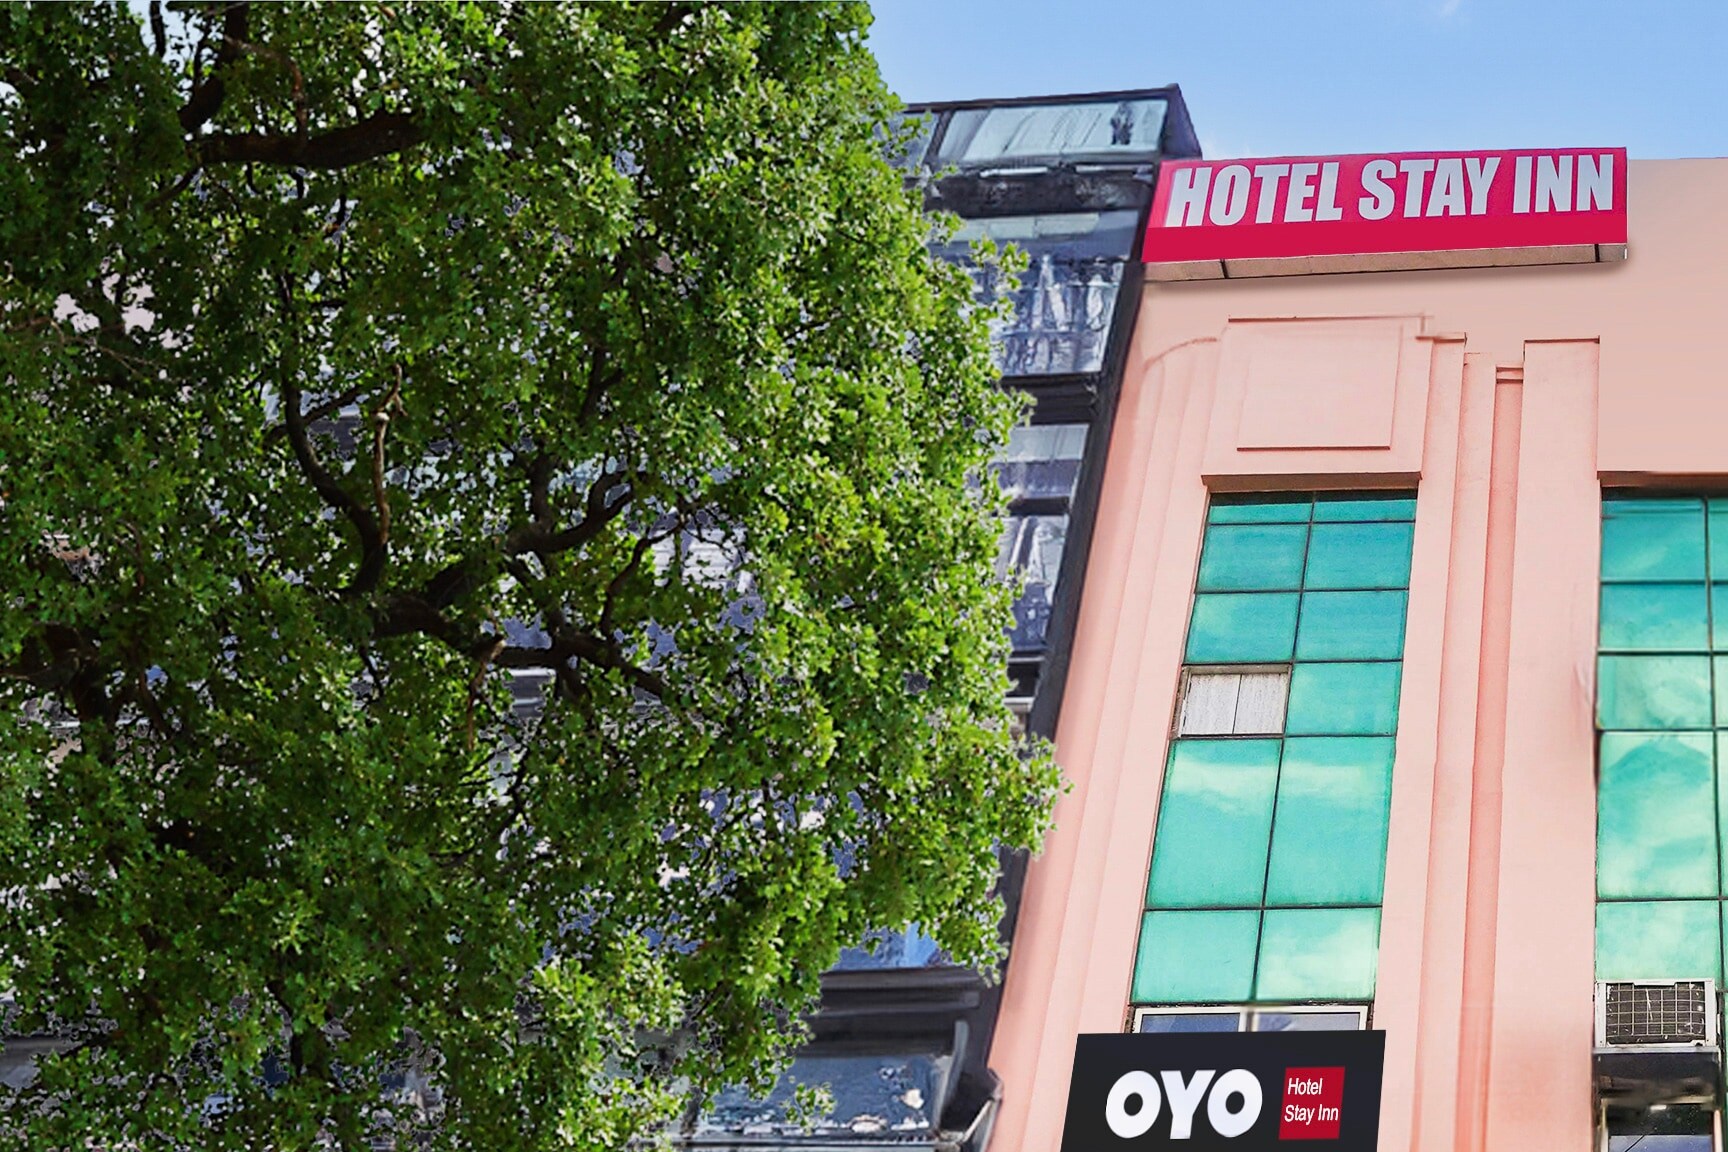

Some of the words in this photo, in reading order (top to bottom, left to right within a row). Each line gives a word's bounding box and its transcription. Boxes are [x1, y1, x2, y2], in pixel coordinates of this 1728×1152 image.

[1164, 159, 1343, 228] HOTEL
[1357, 157, 1501, 221] STAY
[1512, 153, 1614, 215] INN
[1105, 1068, 1263, 1140] OYO
[1287, 1077, 1322, 1096] Hotel
[1284, 1104, 1314, 1125] Stay
[1317, 1103, 1339, 1121] Inn
